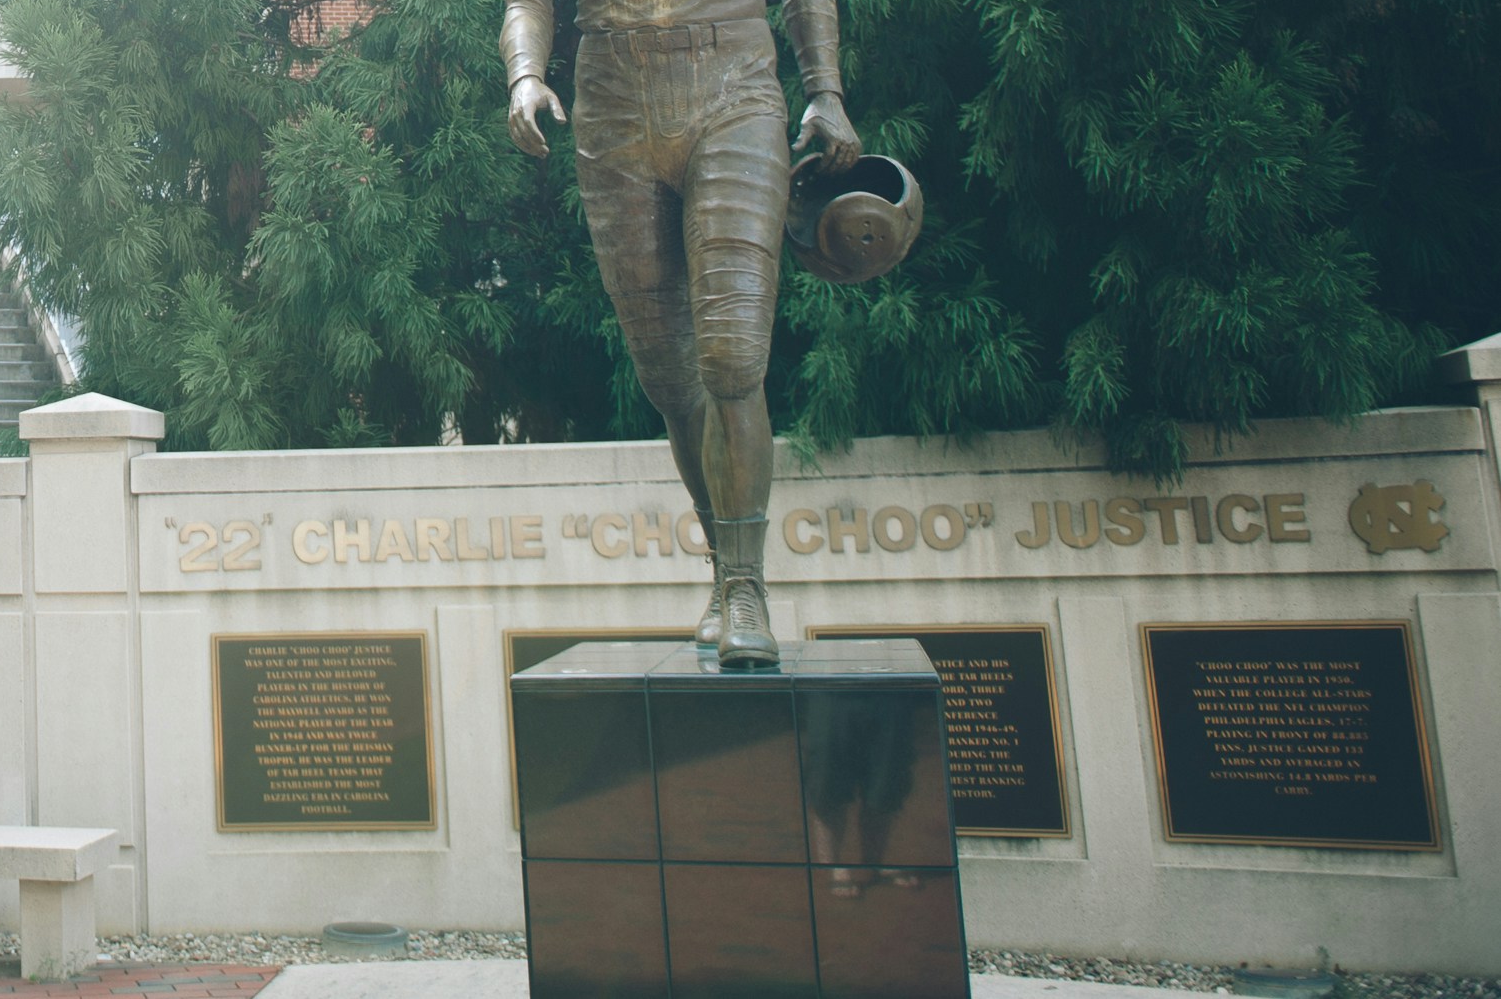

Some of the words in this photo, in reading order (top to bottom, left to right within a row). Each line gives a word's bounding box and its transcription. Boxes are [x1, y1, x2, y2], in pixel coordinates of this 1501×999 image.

[292, 514, 546, 565] CHARLIE
[562, 508, 710, 559] "CHO
[782, 501, 993, 555] CHOO"
[1015, 492, 1311, 549] JUSTICE
[249, 646, 288, 655] CHARLIE
[290, 646, 319, 655] "CHOO
[323, 646, 352, 654] CHOO"
[354, 645, 392, 654] JUSTICE
[244, 659, 262, 667] WAS
[266, 658, 283, 667] ONE
[287, 658, 299, 667] OF
[302, 658, 318, 667] THE
[323, 658, 347, 667] MOST
[351, 658, 397, 666] EXCITING,
[266, 671, 311, 679] TALENTED
[315, 670, 331, 679] AND
[335, 670, 376, 678] BELOVED
[258, 683, 296, 691] PLAYERS
[299, 683, 308, 691] IN
[312, 683, 328, 691] THE
[332, 682, 370, 691] HISTORY
[374, 682, 385, 691] OF
[253, 695, 297, 704] CAROLINA
[301, 694, 351, 703] ATHLETICS.
[355, 694, 367, 703] HE
[370, 694, 391, 703] WON
[969, 698, 992, 706] TWO
[258, 707, 274, 716] THE
[278, 707, 320, 716] MAXWELL
[324, 706, 354, 715] AWARD
[358, 706, 367, 715] AS
[371, 706, 388, 715] THE
[253, 719, 295, 728] NATIONAL
[299, 719, 332, 728] PLAYER
[335, 719, 346, 727] OF
[350, 719, 367, 727] THE
[371, 718, 393, 727] YEAR
[270, 732, 279, 740] IN
[283, 732, 303, 740] 1948
[306, 732, 323, 740] AND
[327, 731, 345, 740] WAS
[349, 731, 378, 739] TWICE
[255, 744, 307, 753] RUNNER-UP
[311, 744, 329, 752] FOR
[333, 744, 350, 752] THE
[353, 744, 393, 752] HEISMAN
[991, 751, 1010, 759] THE
[258, 756, 295, 765] TROPHY.
[299, 756, 311, 765] HE
[314, 756, 332, 765] WAS
[336, 756, 353, 764] THE
[357, 756, 392, 764] LEADER
[267, 768, 279, 777] OF
[283, 768, 299, 777] TAR
[302, 768, 324, 777] HEEL
[329, 768, 357, 777] TEAMS
[361, 768, 383, 777] THAT
[999, 764, 1024, 772] YEAR
[270, 780, 331, 789] ESTABLISHED
[335, 780, 352, 789] THE
[355, 780, 381, 789] MOST
[979, 777, 1025, 785] RANKING
[263, 793, 309, 802] DAZZLING
[311, 793, 329, 802] ERA
[332, 793, 341, 802] IN
[345, 793, 389, 801] CAROLINA
[301, 805, 351, 814] FOOTBALL.
